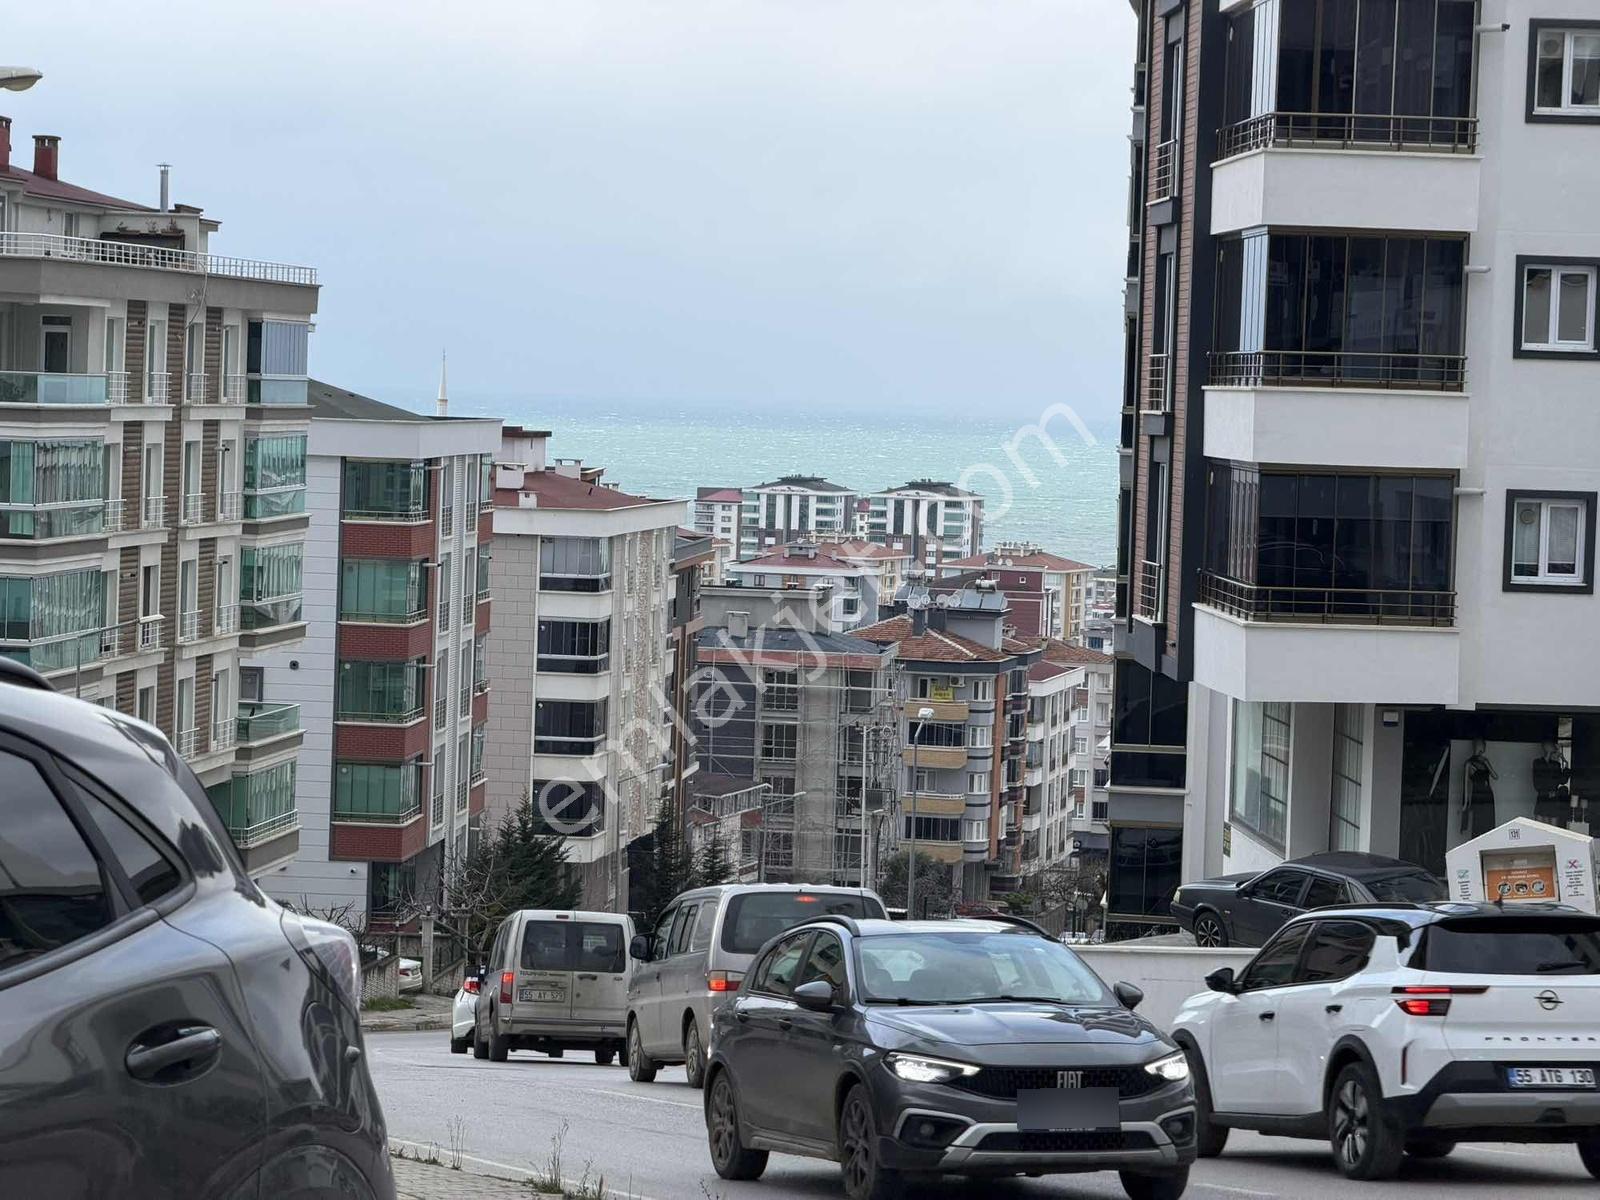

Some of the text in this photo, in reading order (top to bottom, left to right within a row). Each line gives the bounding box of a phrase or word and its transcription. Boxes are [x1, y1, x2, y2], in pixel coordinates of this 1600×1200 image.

[1057, 1071, 1084, 1088] FIAT
[1516, 1069, 1533, 1083] 55
[1569, 1069, 1595, 1083] 130
